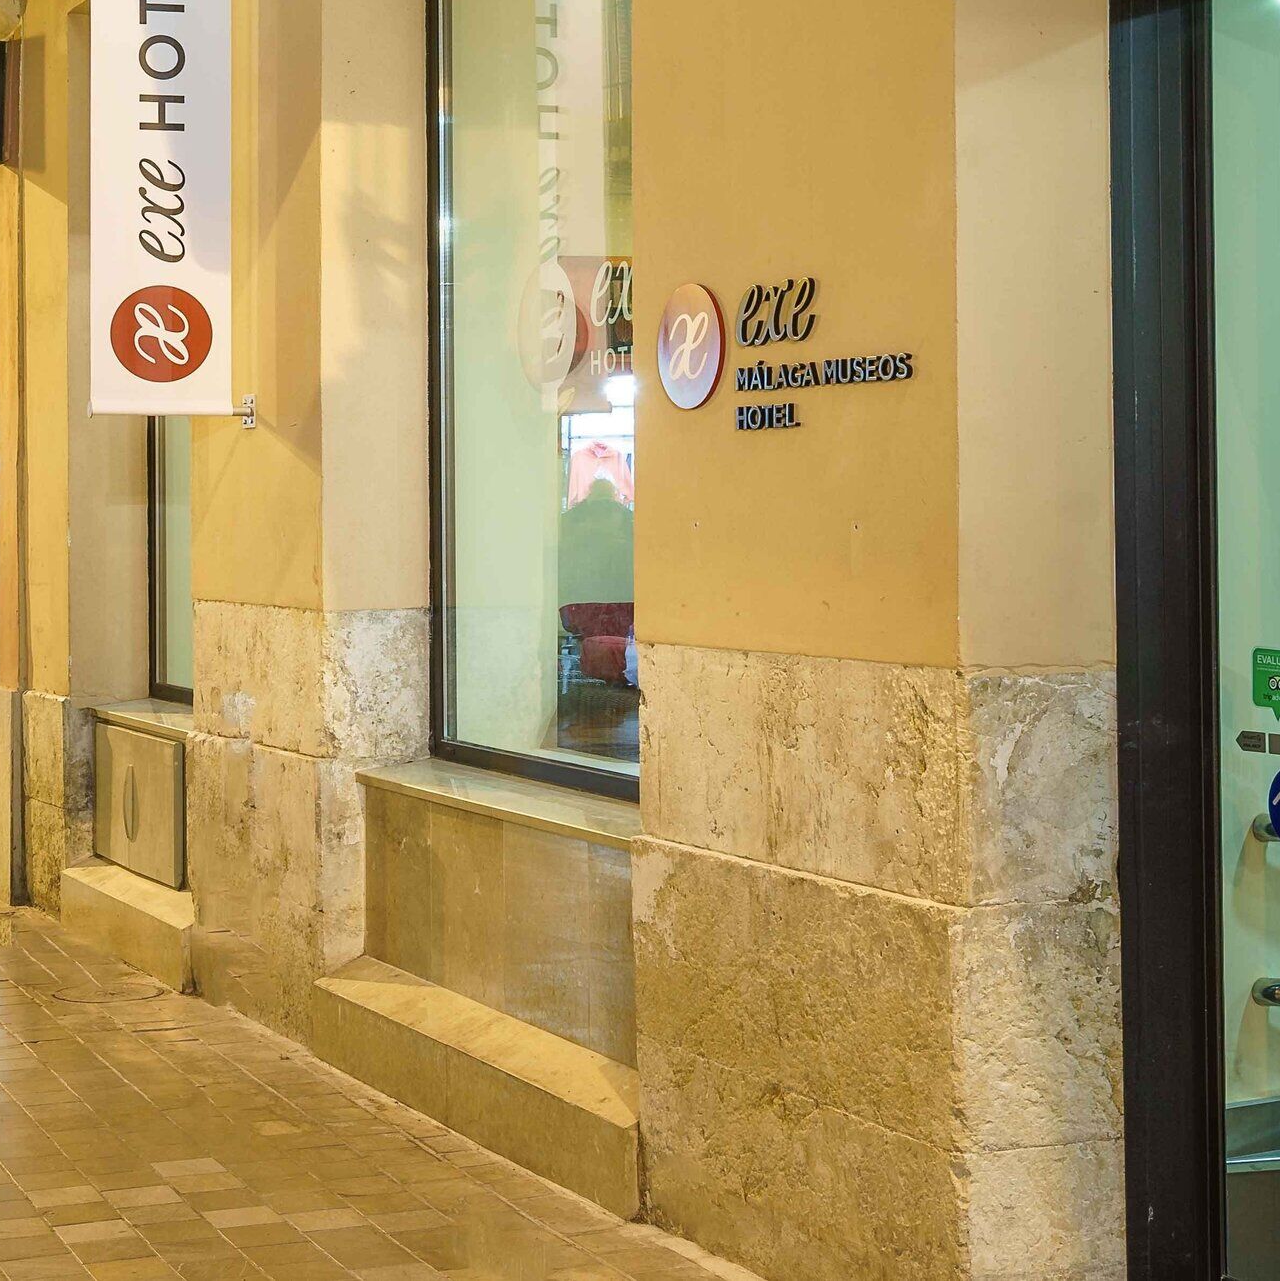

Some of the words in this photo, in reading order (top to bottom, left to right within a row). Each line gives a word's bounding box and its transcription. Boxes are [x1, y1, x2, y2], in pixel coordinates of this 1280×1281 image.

[138, 157, 186, 264] exe
[734, 276, 817, 348] exe
[735, 360, 820, 391] MÁLAGA
[822, 352, 914, 387] MUSEOS
[735, 402, 801, 430] HOTEL
